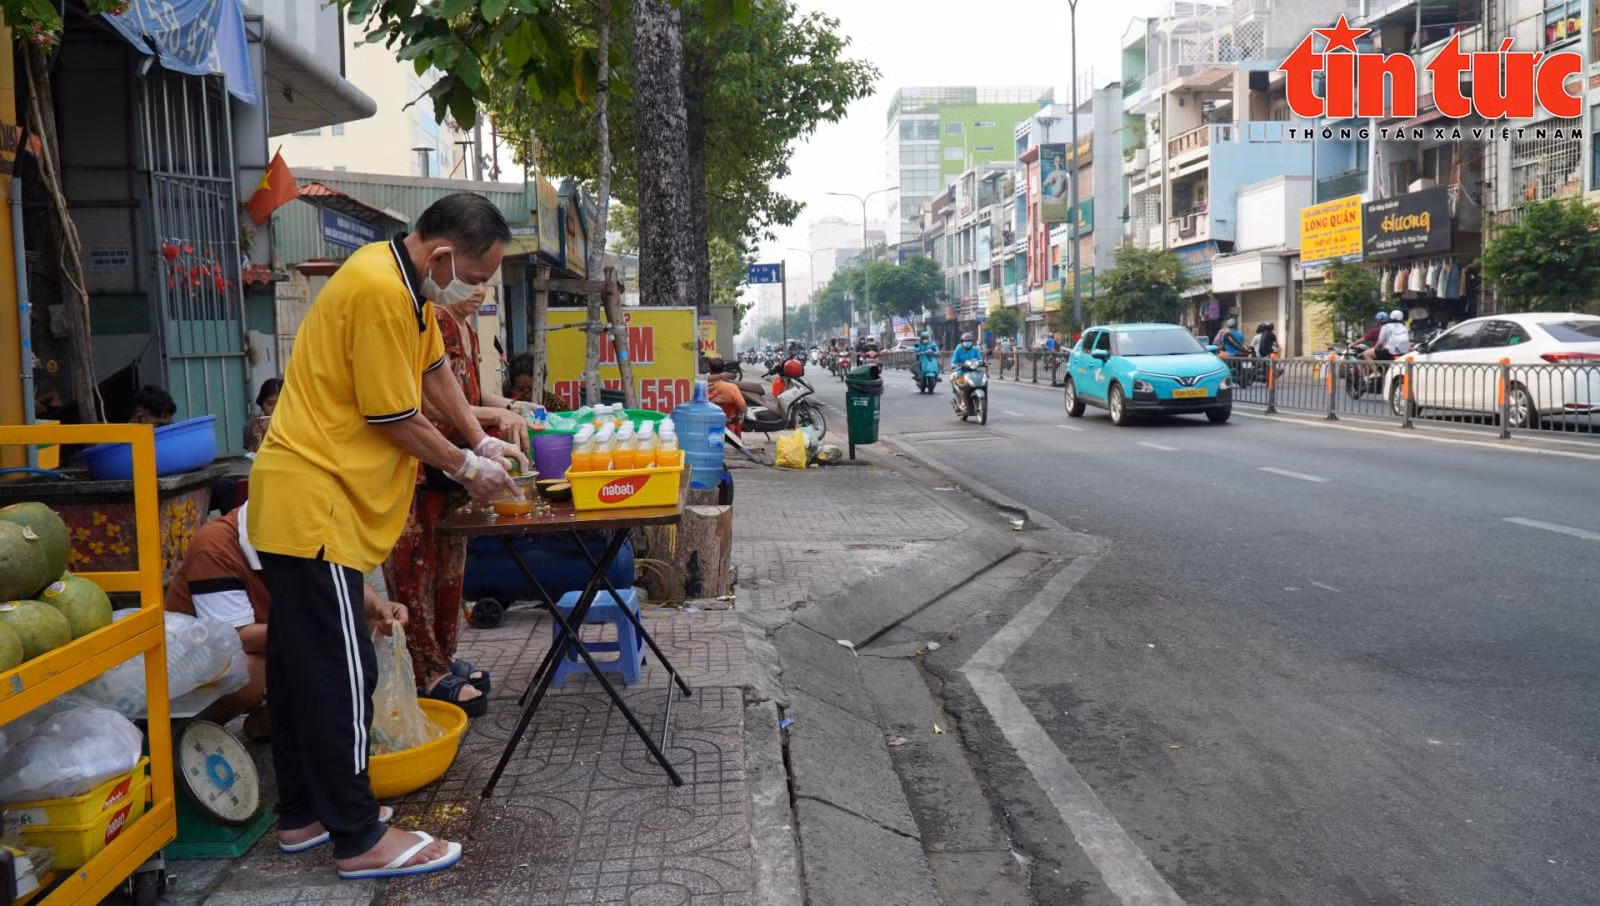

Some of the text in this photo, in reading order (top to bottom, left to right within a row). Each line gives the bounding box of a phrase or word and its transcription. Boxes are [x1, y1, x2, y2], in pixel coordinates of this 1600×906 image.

[1304, 216, 1328, 232] LONG
[641, 378, 690, 414] 550
[602, 483, 634, 496] nabati
